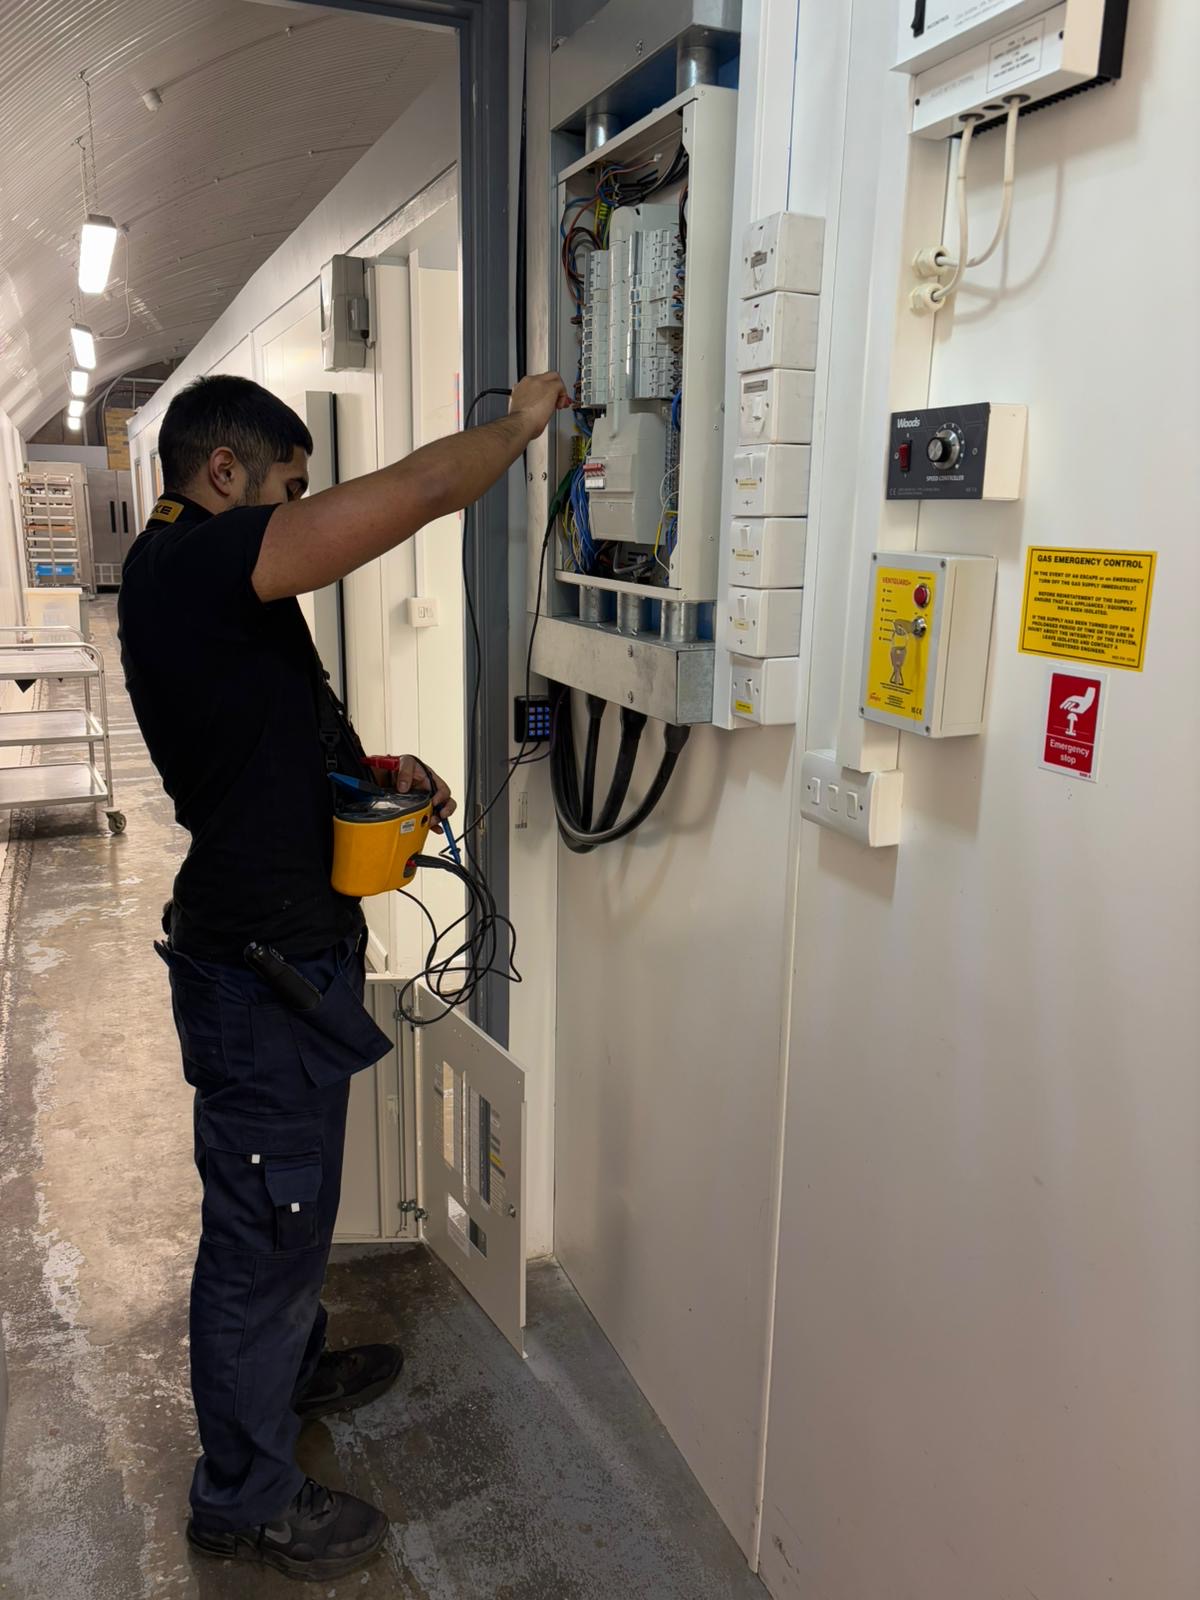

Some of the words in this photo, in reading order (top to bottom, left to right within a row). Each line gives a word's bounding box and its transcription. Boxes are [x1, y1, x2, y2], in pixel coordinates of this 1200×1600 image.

[897, 416, 920, 428] Woods
[1054, 556, 1101, 565] EMERGENCY
[1103, 559, 1143, 568] CONTROL
[1050, 739, 1090, 757] Emergency
[1060, 753, 1077, 765] stop
